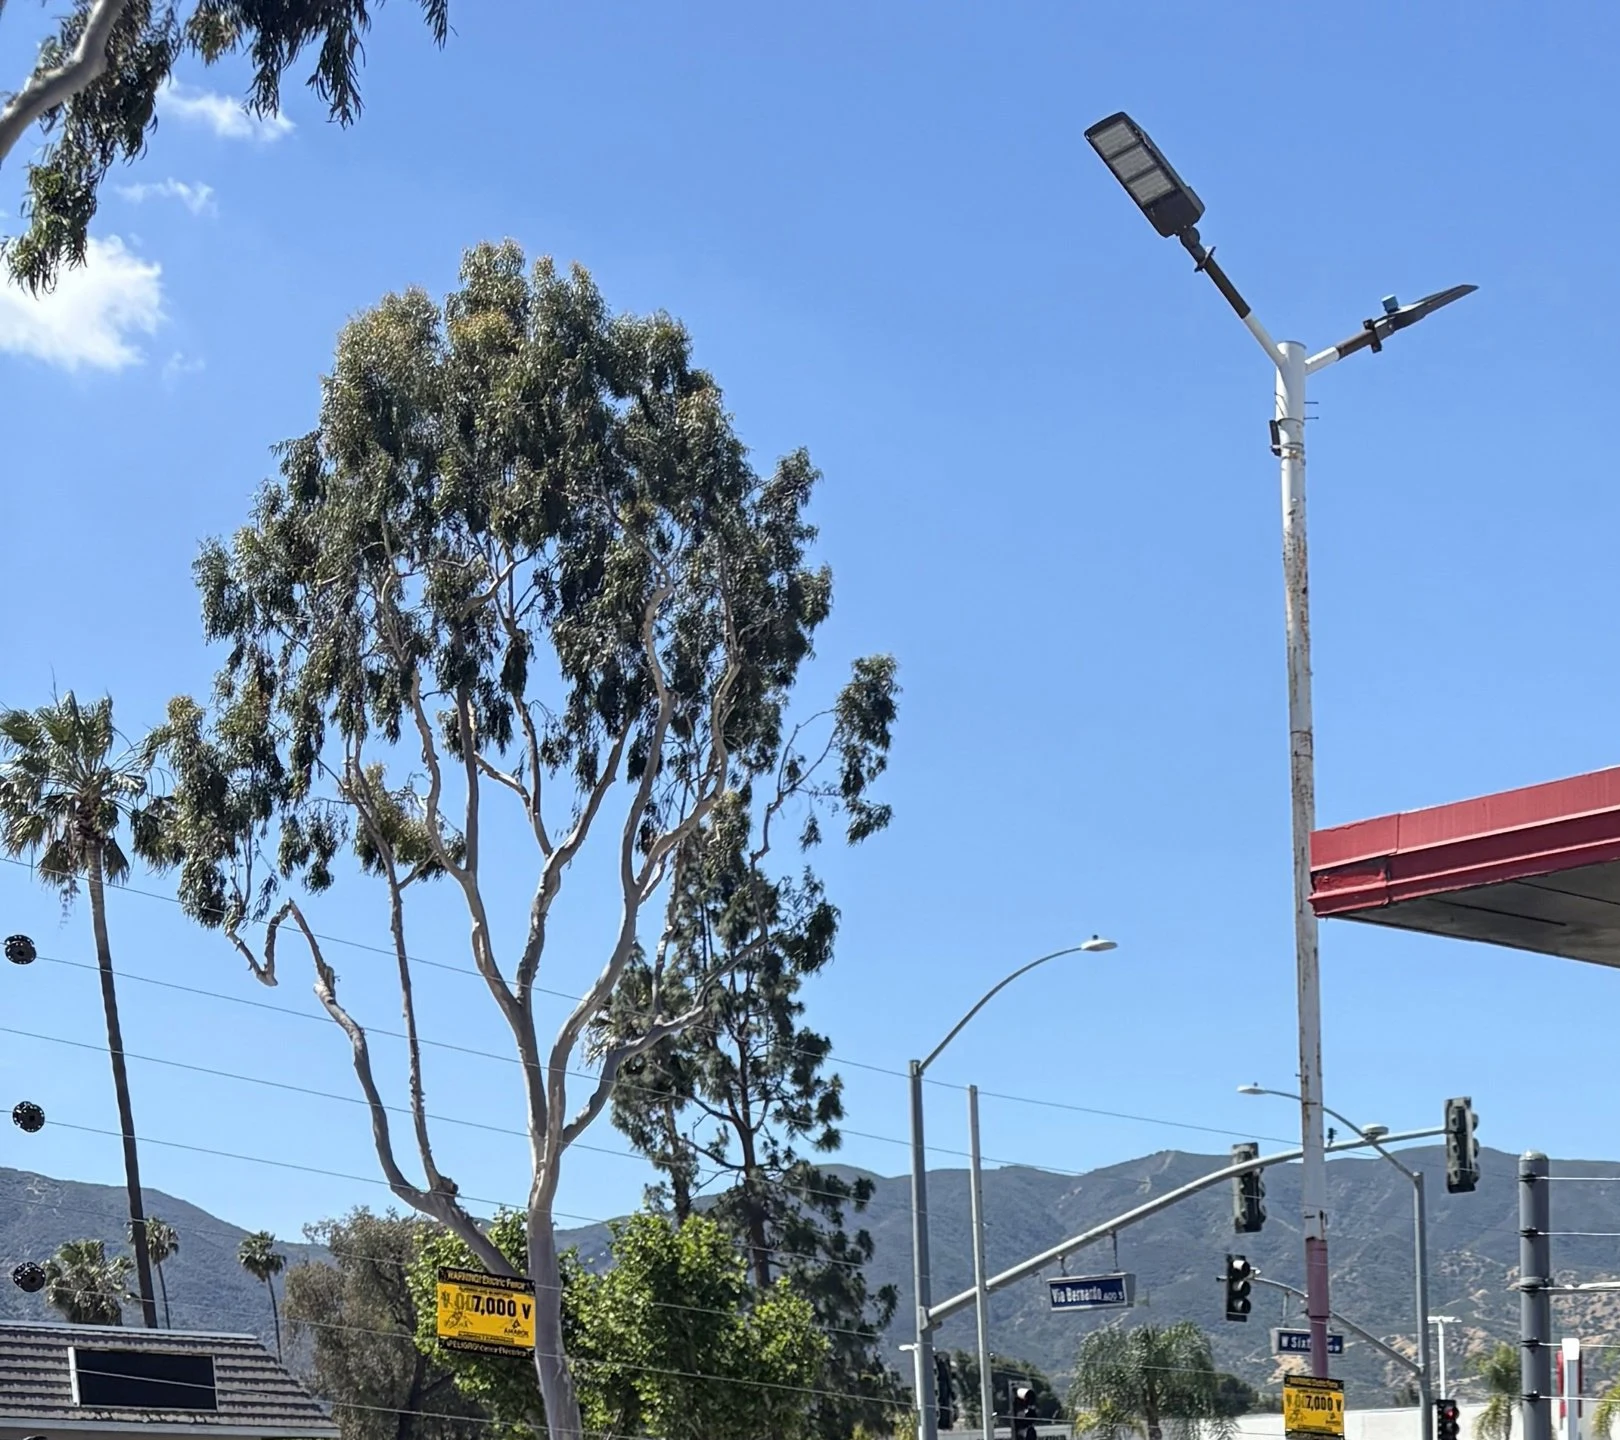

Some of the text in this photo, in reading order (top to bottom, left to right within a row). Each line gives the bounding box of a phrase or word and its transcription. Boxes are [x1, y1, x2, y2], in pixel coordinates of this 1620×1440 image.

[1051, 1288, 1066, 1304] Via
[1065, 1286, 1102, 1303] Bernardo
[472, 1295, 531, 1320] 7,000 V
[1305, 1394, 1333, 1412] 7,000
